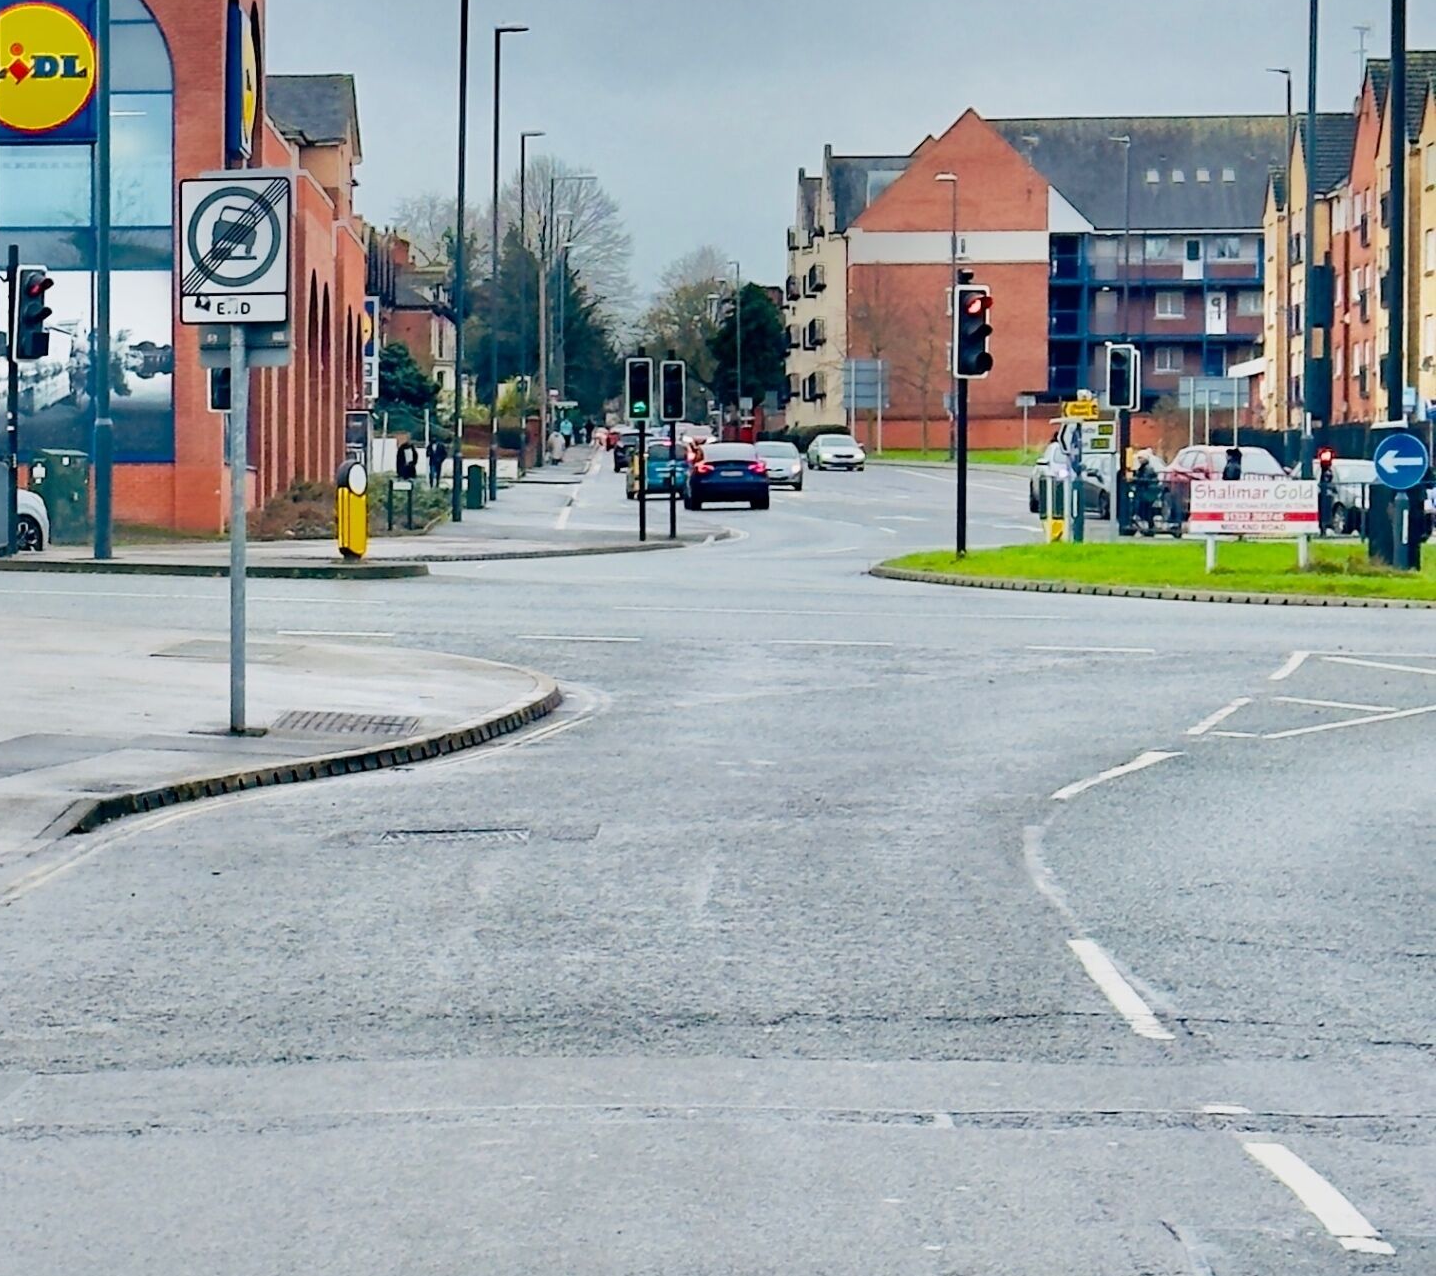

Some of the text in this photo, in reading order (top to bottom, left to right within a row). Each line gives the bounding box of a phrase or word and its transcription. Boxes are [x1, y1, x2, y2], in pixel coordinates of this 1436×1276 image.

[217, 302, 251, 315] ED
[1194, 483, 1314, 500] Shalimar Gold
